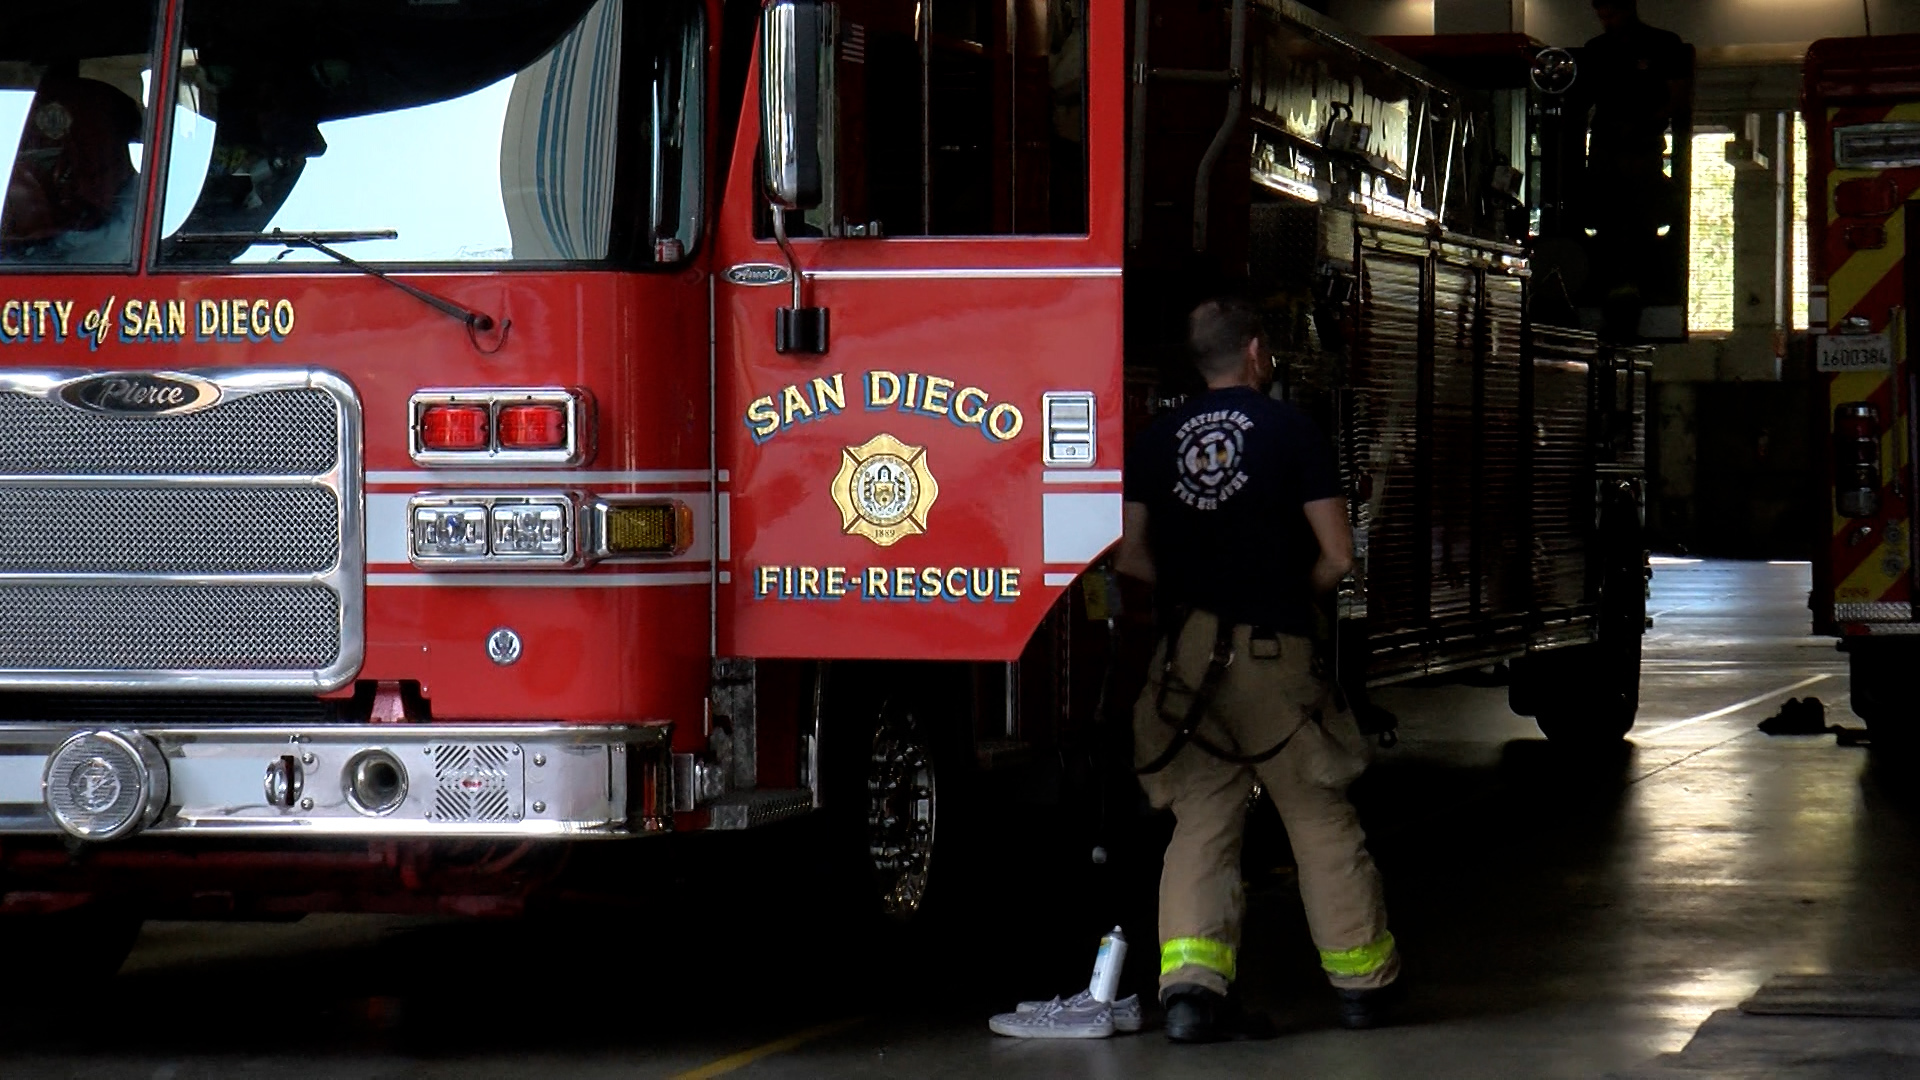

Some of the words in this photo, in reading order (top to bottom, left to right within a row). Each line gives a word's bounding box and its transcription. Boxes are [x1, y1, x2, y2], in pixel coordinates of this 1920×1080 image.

[1, 299, 73, 343] CITY
[79, 295, 116, 350] of
[120, 299, 187, 343] SAN
[196, 298, 295, 343] DIEGO
[95, 378, 185, 407] Pierce
[744, 371, 847, 445] SAN
[864, 370, 1024, 443] DIEGO
[1204, 443, 1219, 472] 1
[875, 529, 896, 538] 1889
[756, 566, 1021, 602] FIRE-RESCUE
